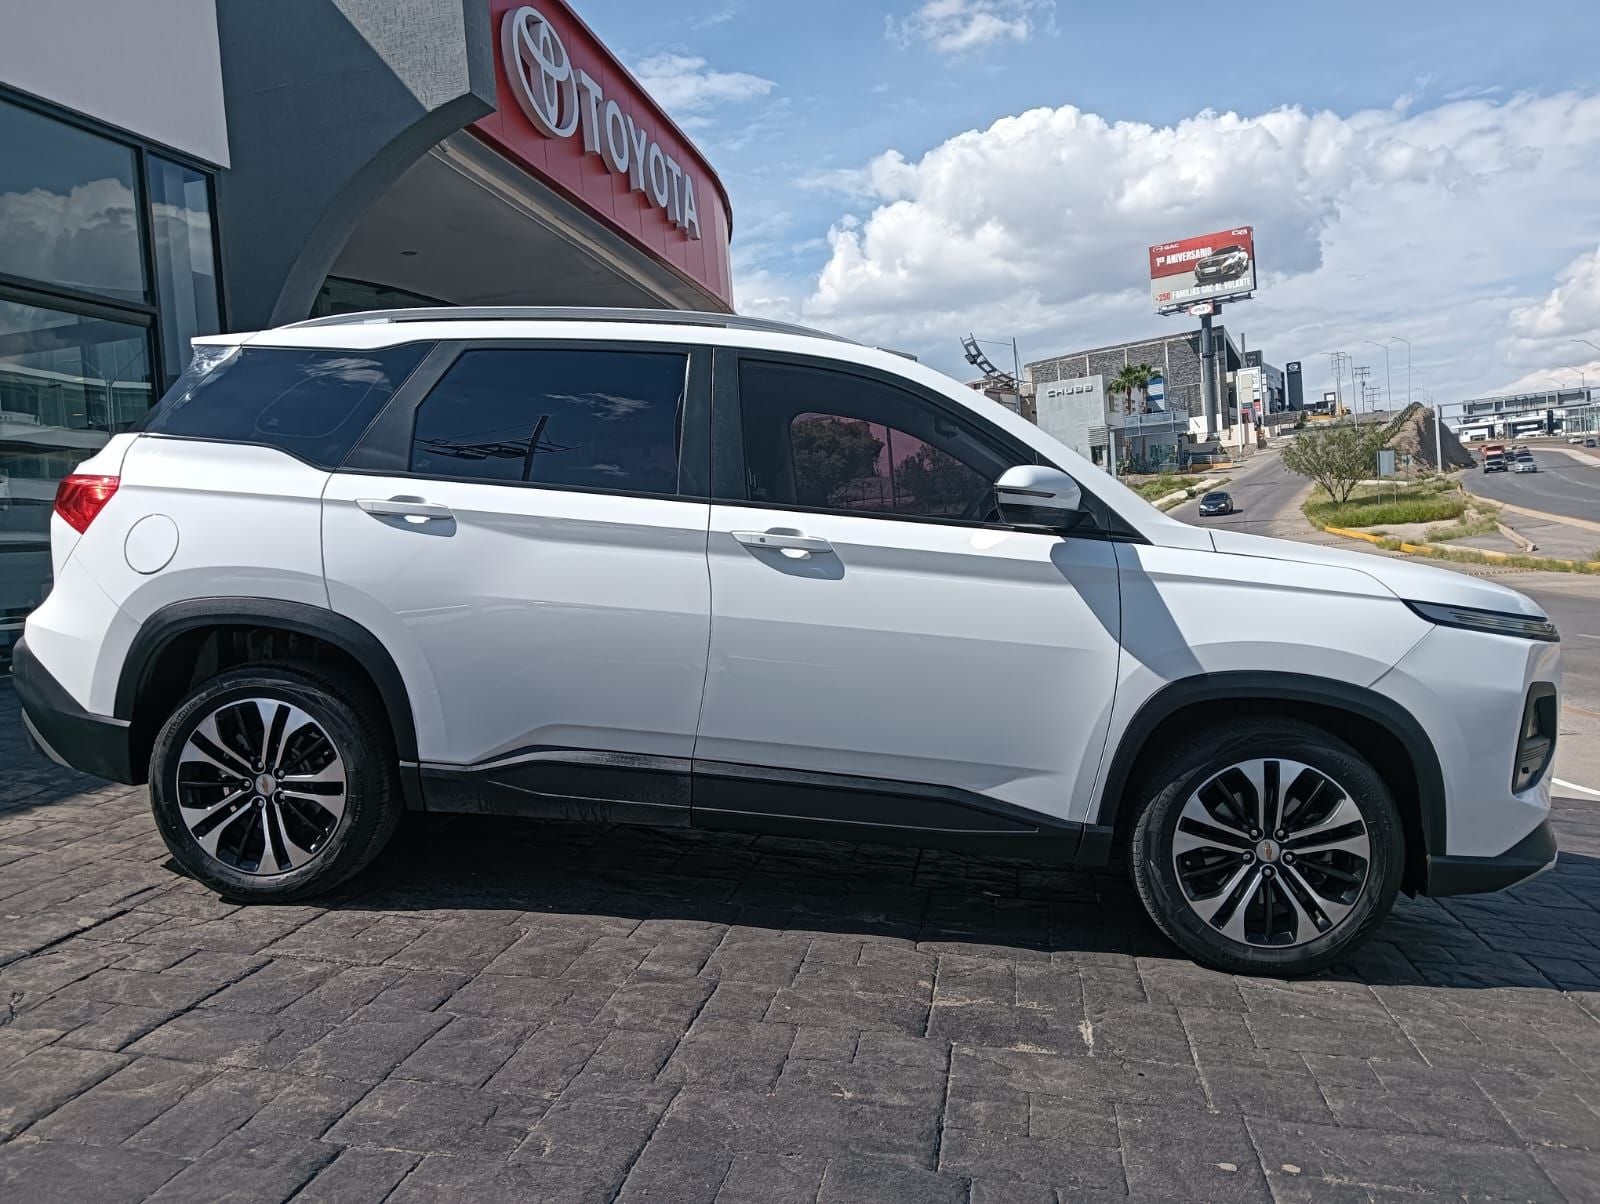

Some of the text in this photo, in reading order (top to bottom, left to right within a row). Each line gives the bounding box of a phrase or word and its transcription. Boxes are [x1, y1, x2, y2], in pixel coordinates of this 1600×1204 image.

[577, 69, 700, 241] TOYOTA
[1166, 247, 1212, 265] ANIVERSARIO
[1172, 287, 1201, 299] FAMILIAS
